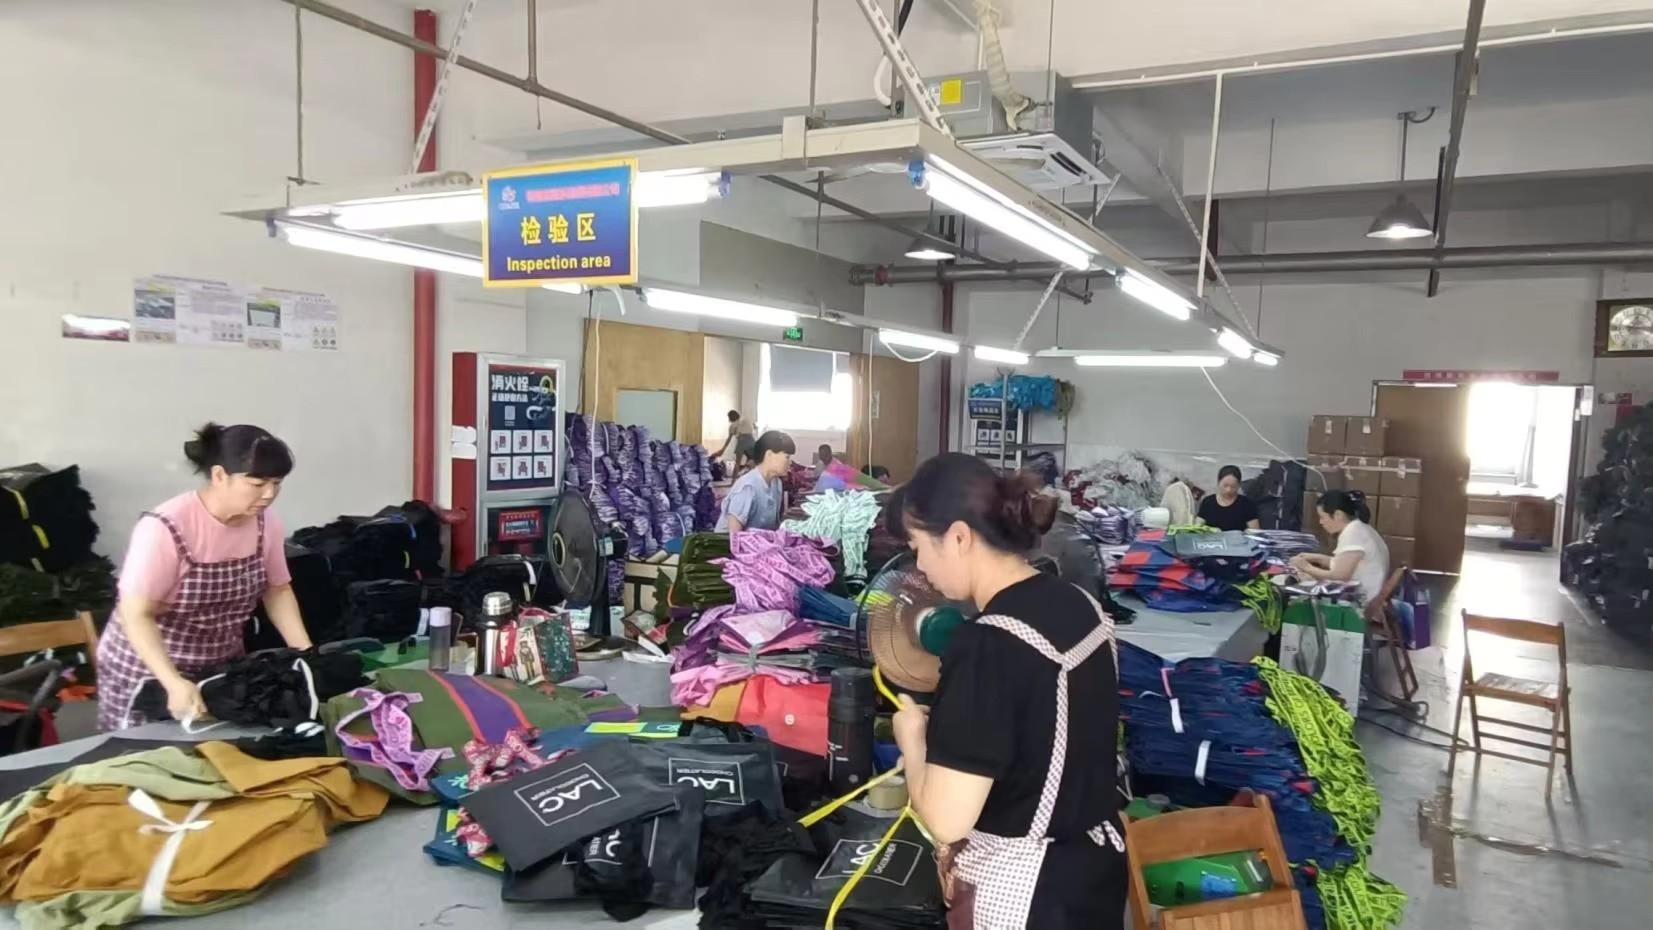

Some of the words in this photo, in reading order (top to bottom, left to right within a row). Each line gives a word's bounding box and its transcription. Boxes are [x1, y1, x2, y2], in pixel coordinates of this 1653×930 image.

[521, 213, 596, 246] 检验区
[507, 255, 577, 274] Inspection
[581, 255, 611, 268] area
[538, 779, 603, 813] LAC
